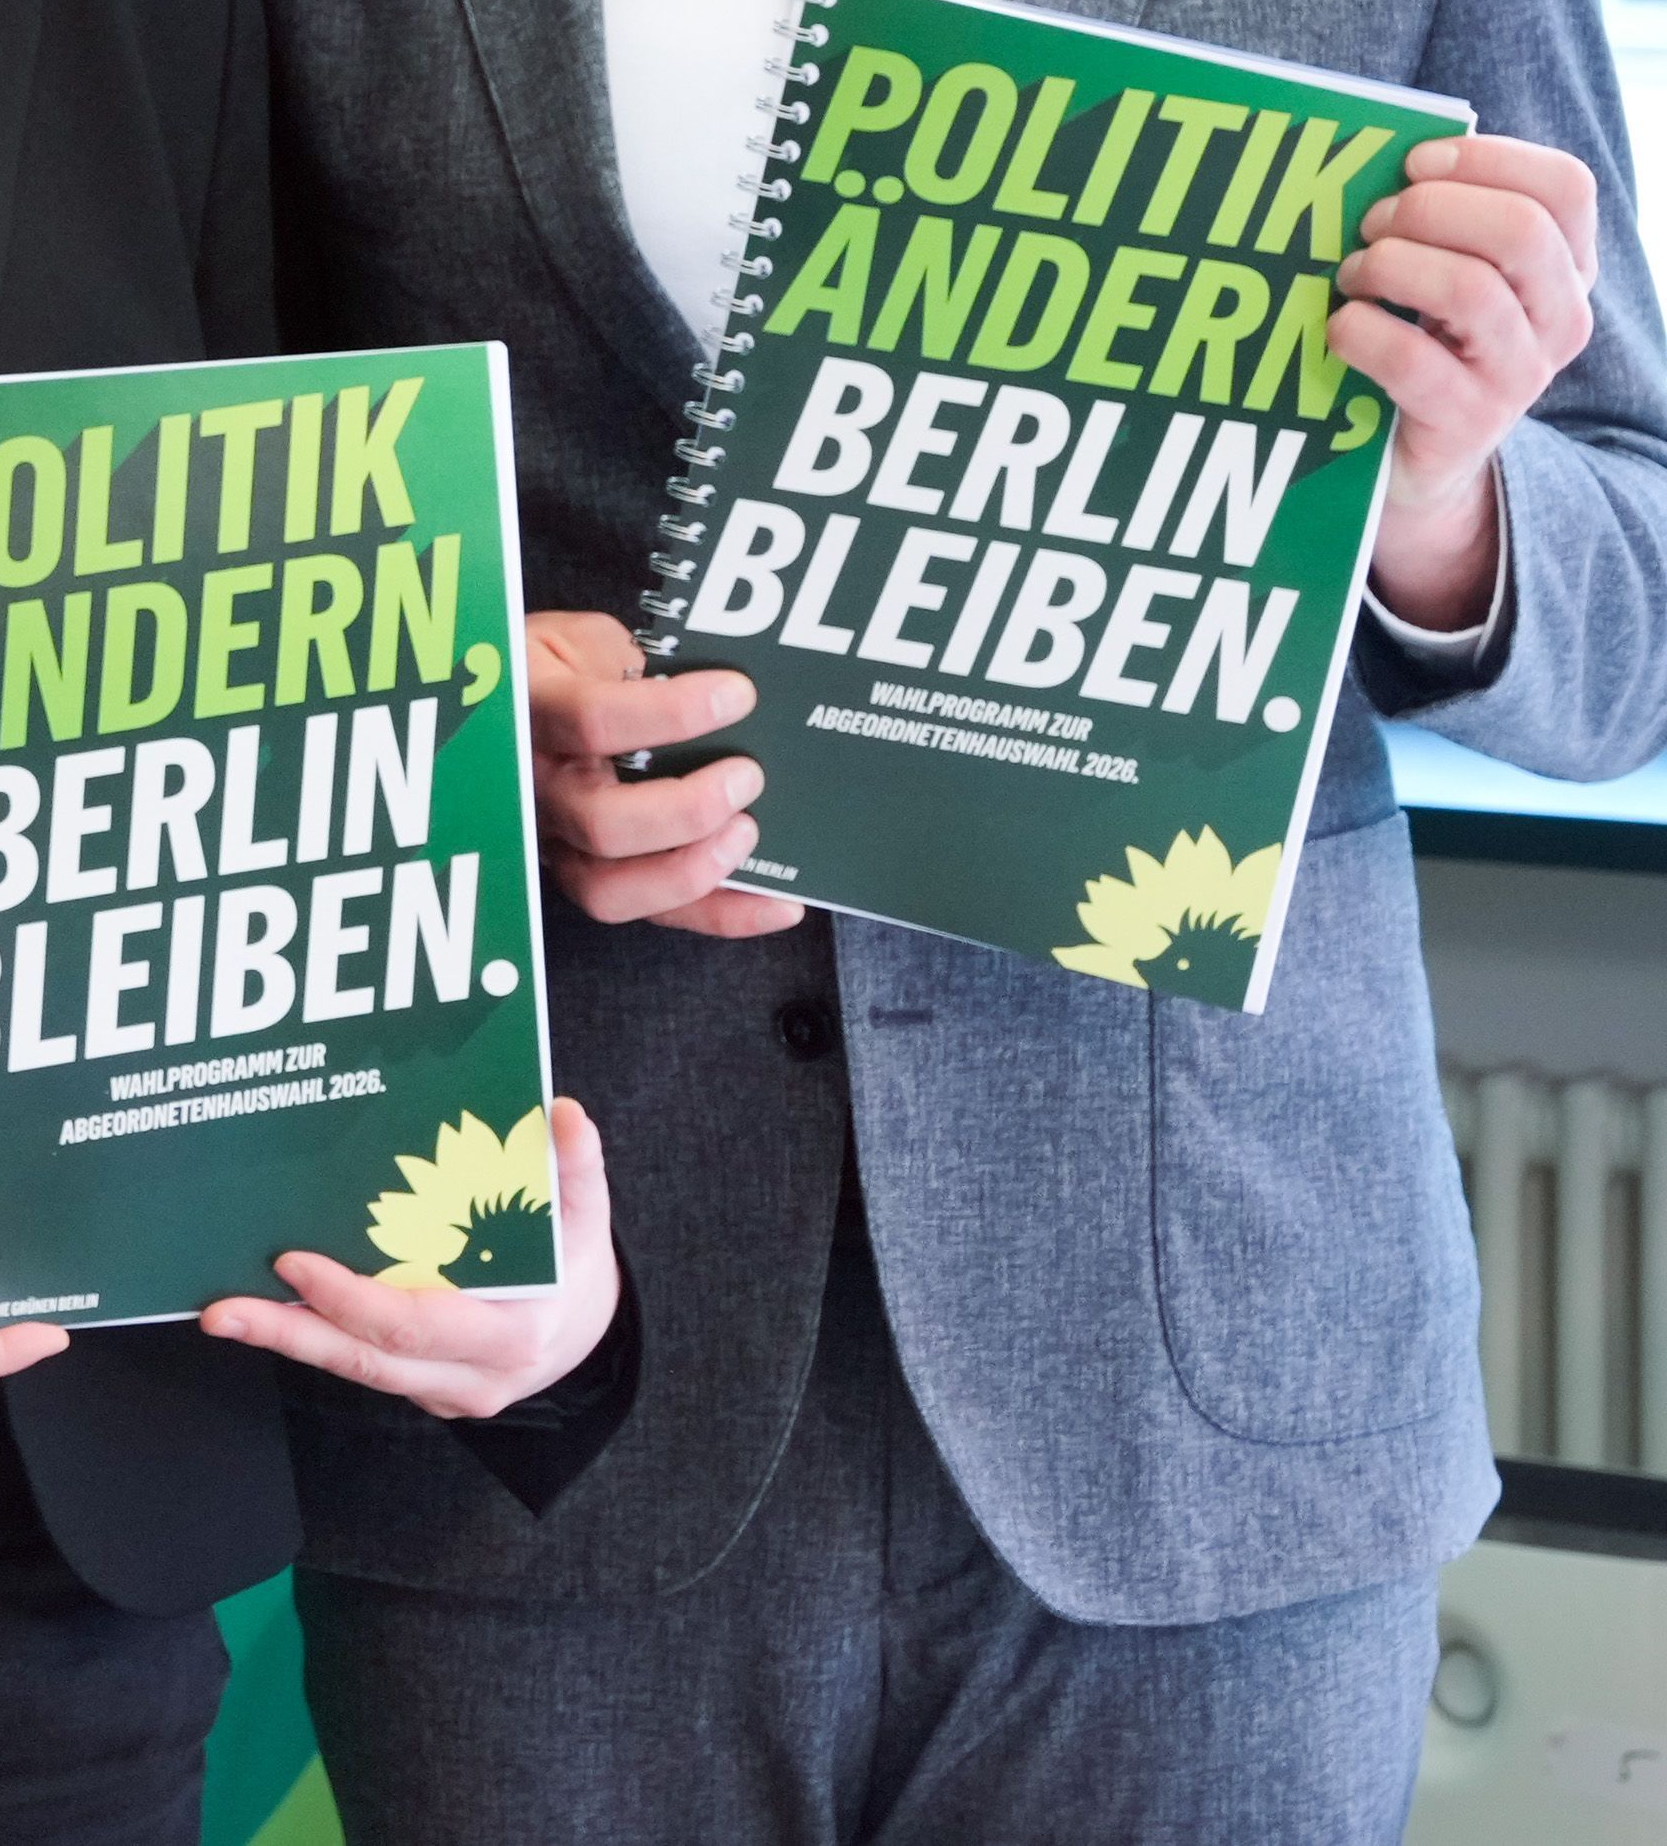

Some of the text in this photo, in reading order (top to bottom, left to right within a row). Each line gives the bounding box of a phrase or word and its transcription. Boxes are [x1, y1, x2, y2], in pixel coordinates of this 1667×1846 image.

[799, 44, 1396, 265] POLITIK
[763, 165, 1381, 452] ÄNDERN,
[772, 356, 1307, 568] BERLIN
[684, 498, 1302, 734] BLEIBEN.
[806, 704, 1140, 784] ABGEORDNETENHAUSWAHL 2026.
[869, 681, 1093, 742] WAHLPROGRAMM ZUR
[59, 1069, 387, 1146] ABGEORDNETENHAUSWAHL 2026.
[110, 1042, 327, 1102] WAHLPROGRAMM ZUR
